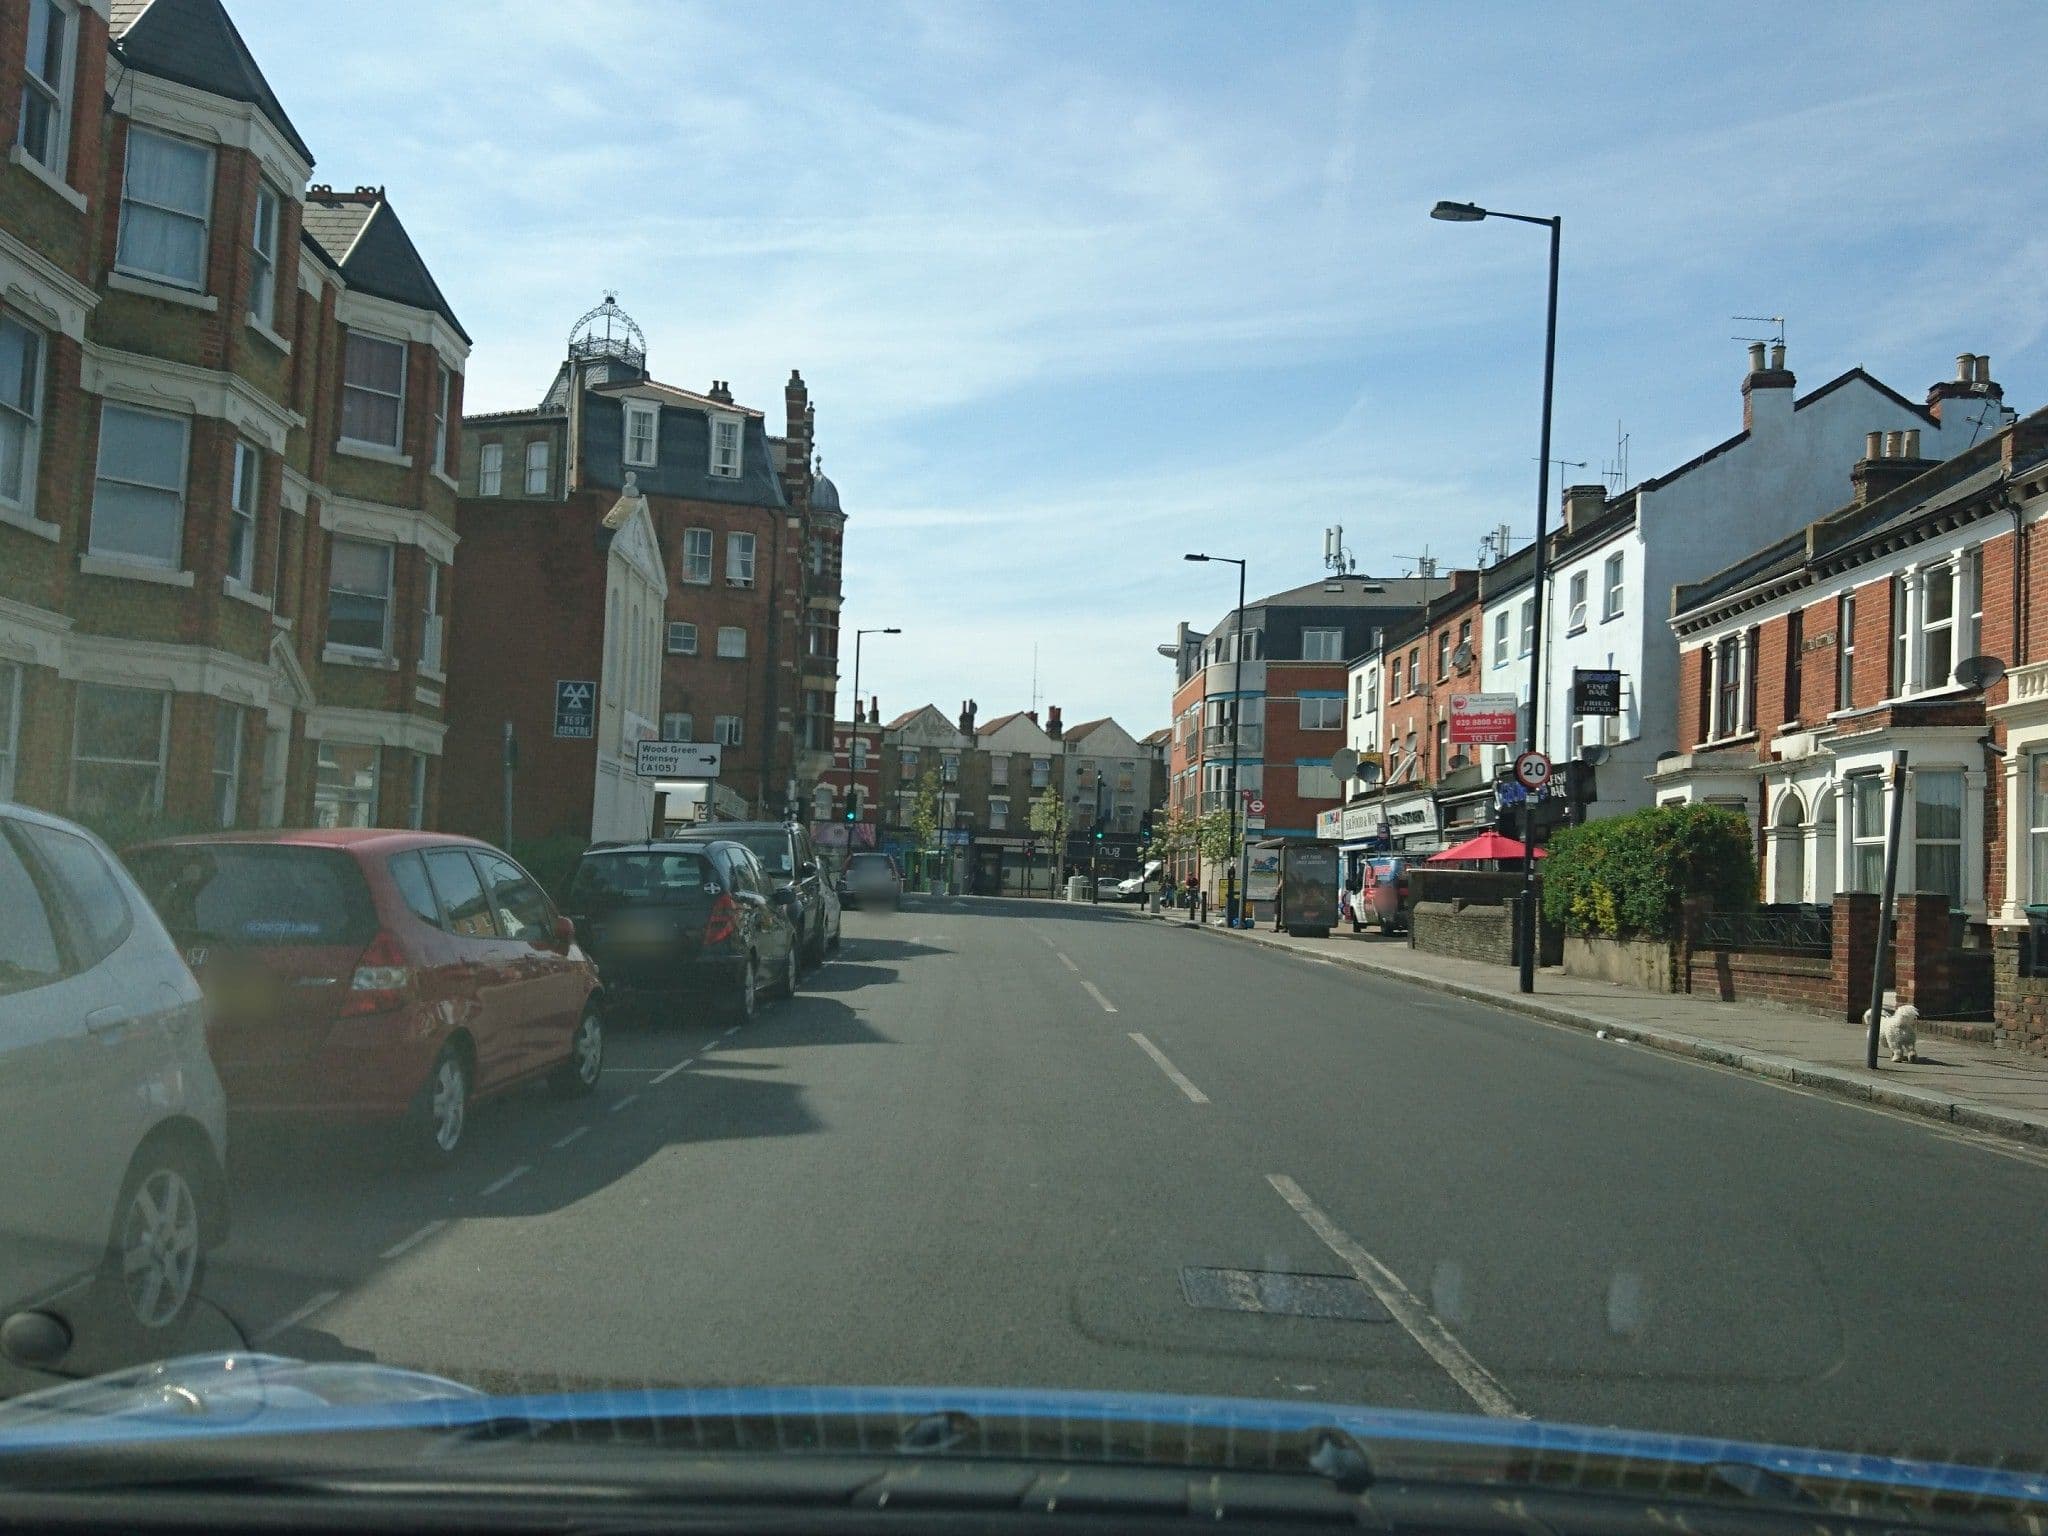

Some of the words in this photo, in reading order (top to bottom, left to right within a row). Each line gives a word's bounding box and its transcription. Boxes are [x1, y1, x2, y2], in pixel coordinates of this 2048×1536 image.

[563, 715, 586, 726] TEST
[558, 725, 591, 736] CENTRE
[642, 745, 668, 753] Wood
[671, 745, 698, 754] Green
[641, 754, 679, 764] Hornsey
[641, 763, 677, 772] (A105)
[1523, 762, 1546, 776] 20
[1099, 846, 1121, 858] nug
